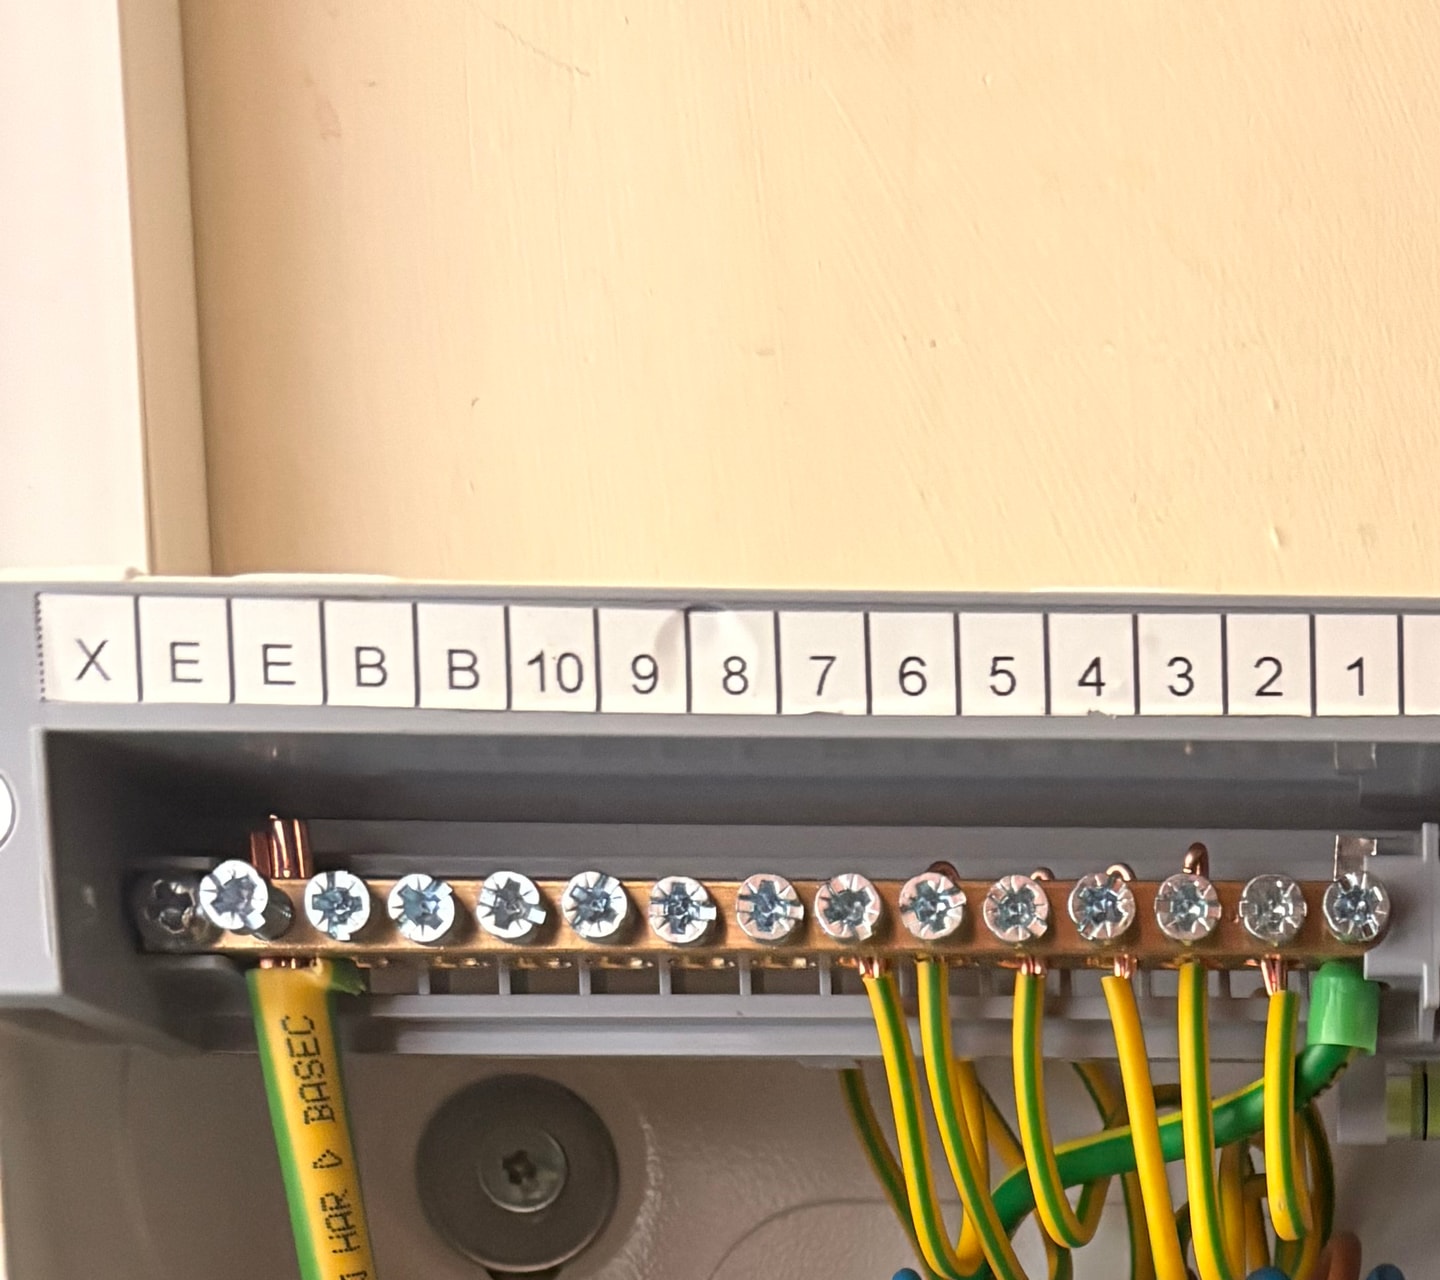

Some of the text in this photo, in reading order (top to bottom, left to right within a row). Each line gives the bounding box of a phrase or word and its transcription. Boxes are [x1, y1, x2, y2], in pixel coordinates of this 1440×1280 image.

[76, 639, 1364, 697] X E E B B 10 9 8 7 6 5 4 3 2 1
[280, 1013, 336, 1126] BASEC
[319, 1186, 361, 1255] HAR
